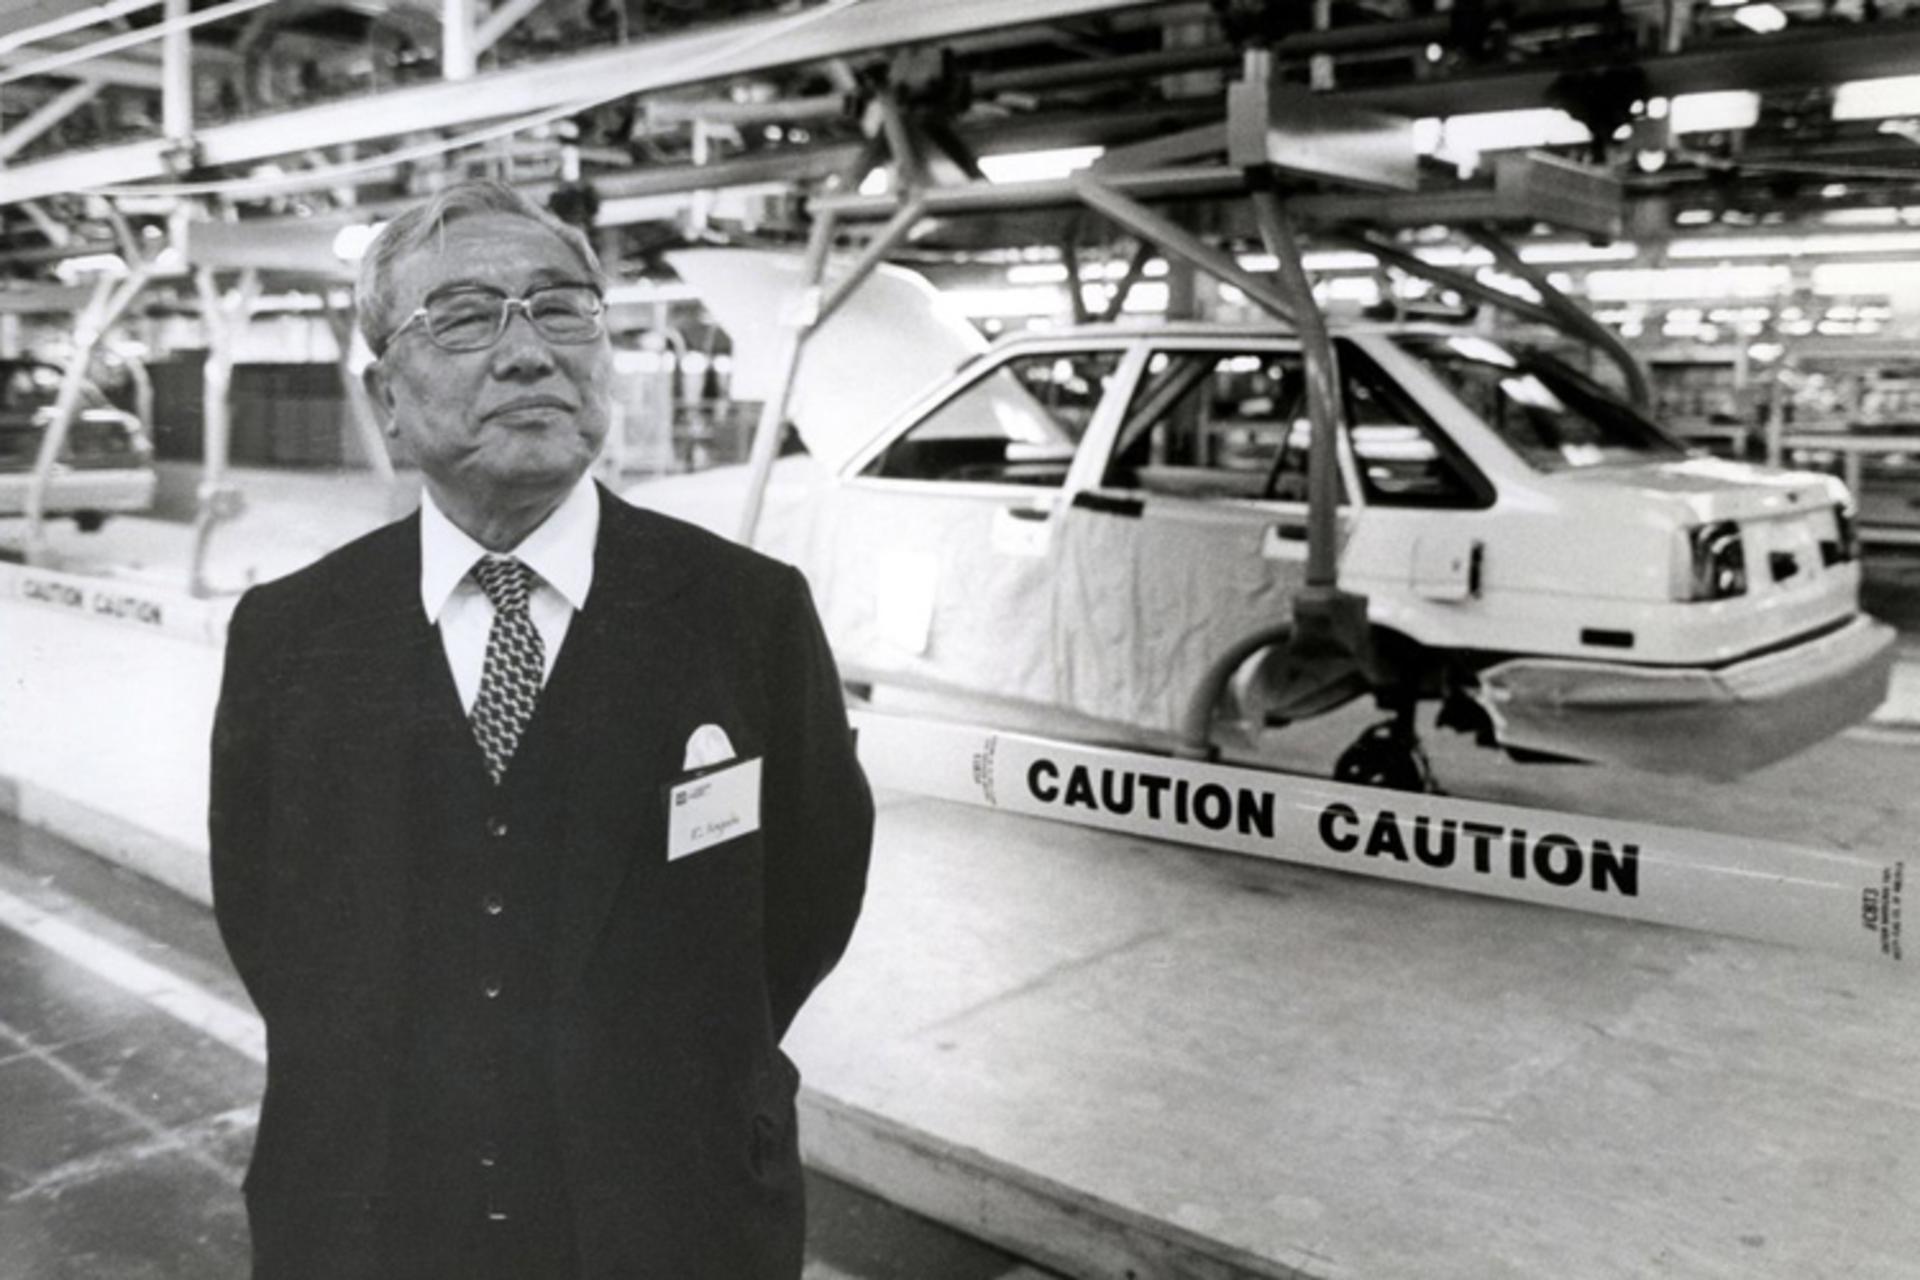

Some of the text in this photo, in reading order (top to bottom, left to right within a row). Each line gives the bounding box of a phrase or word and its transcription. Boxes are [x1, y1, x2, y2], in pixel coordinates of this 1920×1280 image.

[23, 579, 162, 625] CAUTION CAUTION
[1027, 758, 1275, 838] CAUTION
[1317, 802, 1639, 896] CAUTION
